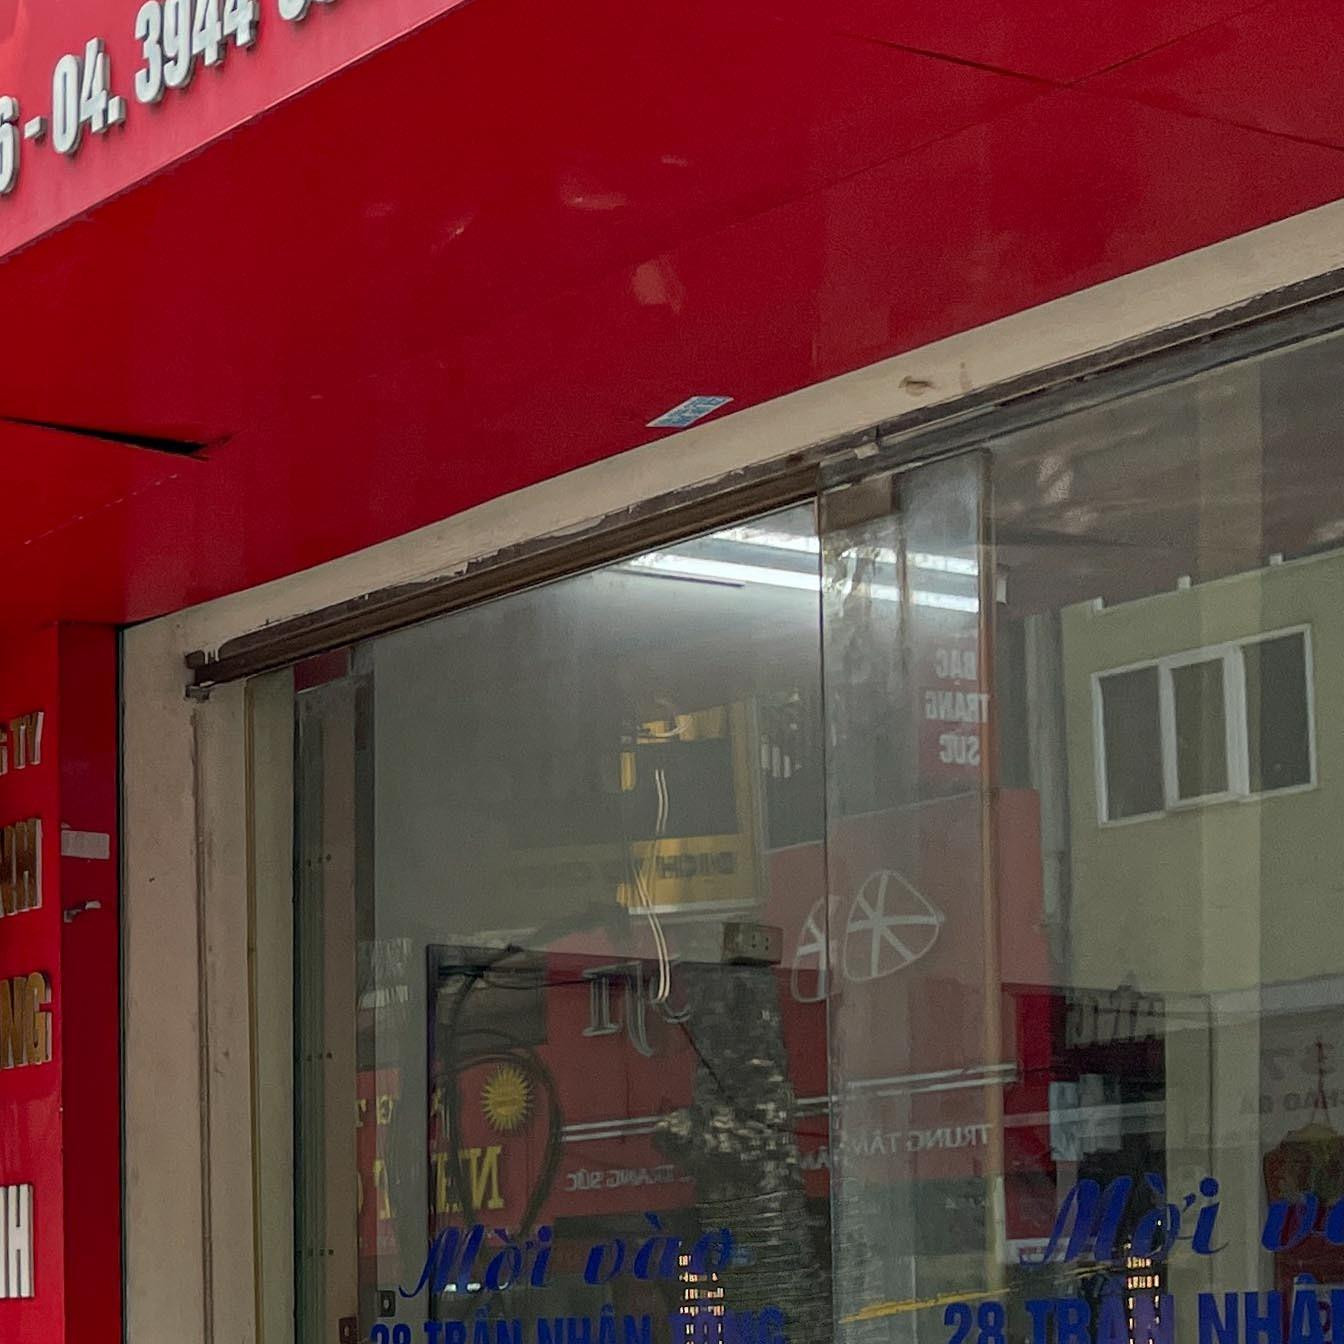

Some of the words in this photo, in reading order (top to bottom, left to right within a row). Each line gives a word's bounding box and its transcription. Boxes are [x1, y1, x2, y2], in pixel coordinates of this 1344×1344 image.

[52, 37, 125, 154] 04.
[9, 711, 45, 769] TY
[1020, 1172, 1230, 1264] Mời
[399, 1224, 553, 1298] Mời
